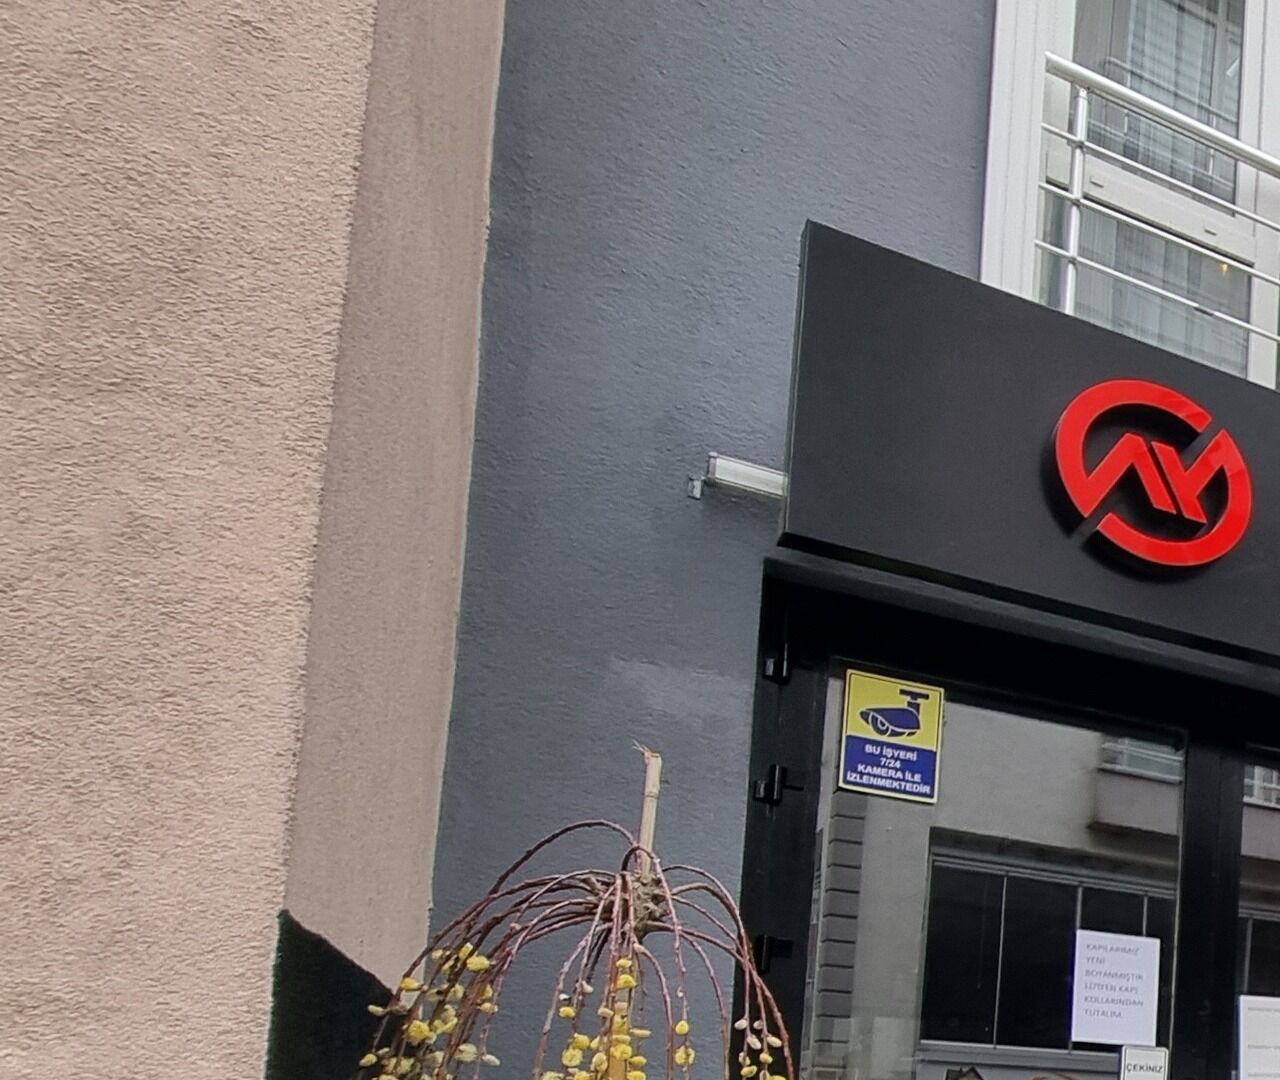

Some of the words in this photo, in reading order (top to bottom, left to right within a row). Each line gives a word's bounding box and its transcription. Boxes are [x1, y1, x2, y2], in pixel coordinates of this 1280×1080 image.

[865, 744, 881, 755] BU
[883, 746, 917, 761] İŞYERİ
[857, 763, 903, 779] KAMERA
[905, 770, 922, 782] İLE
[880, 758, 901, 769] 7/24
[847, 771, 931, 794] İZLENMEKTEDİR
